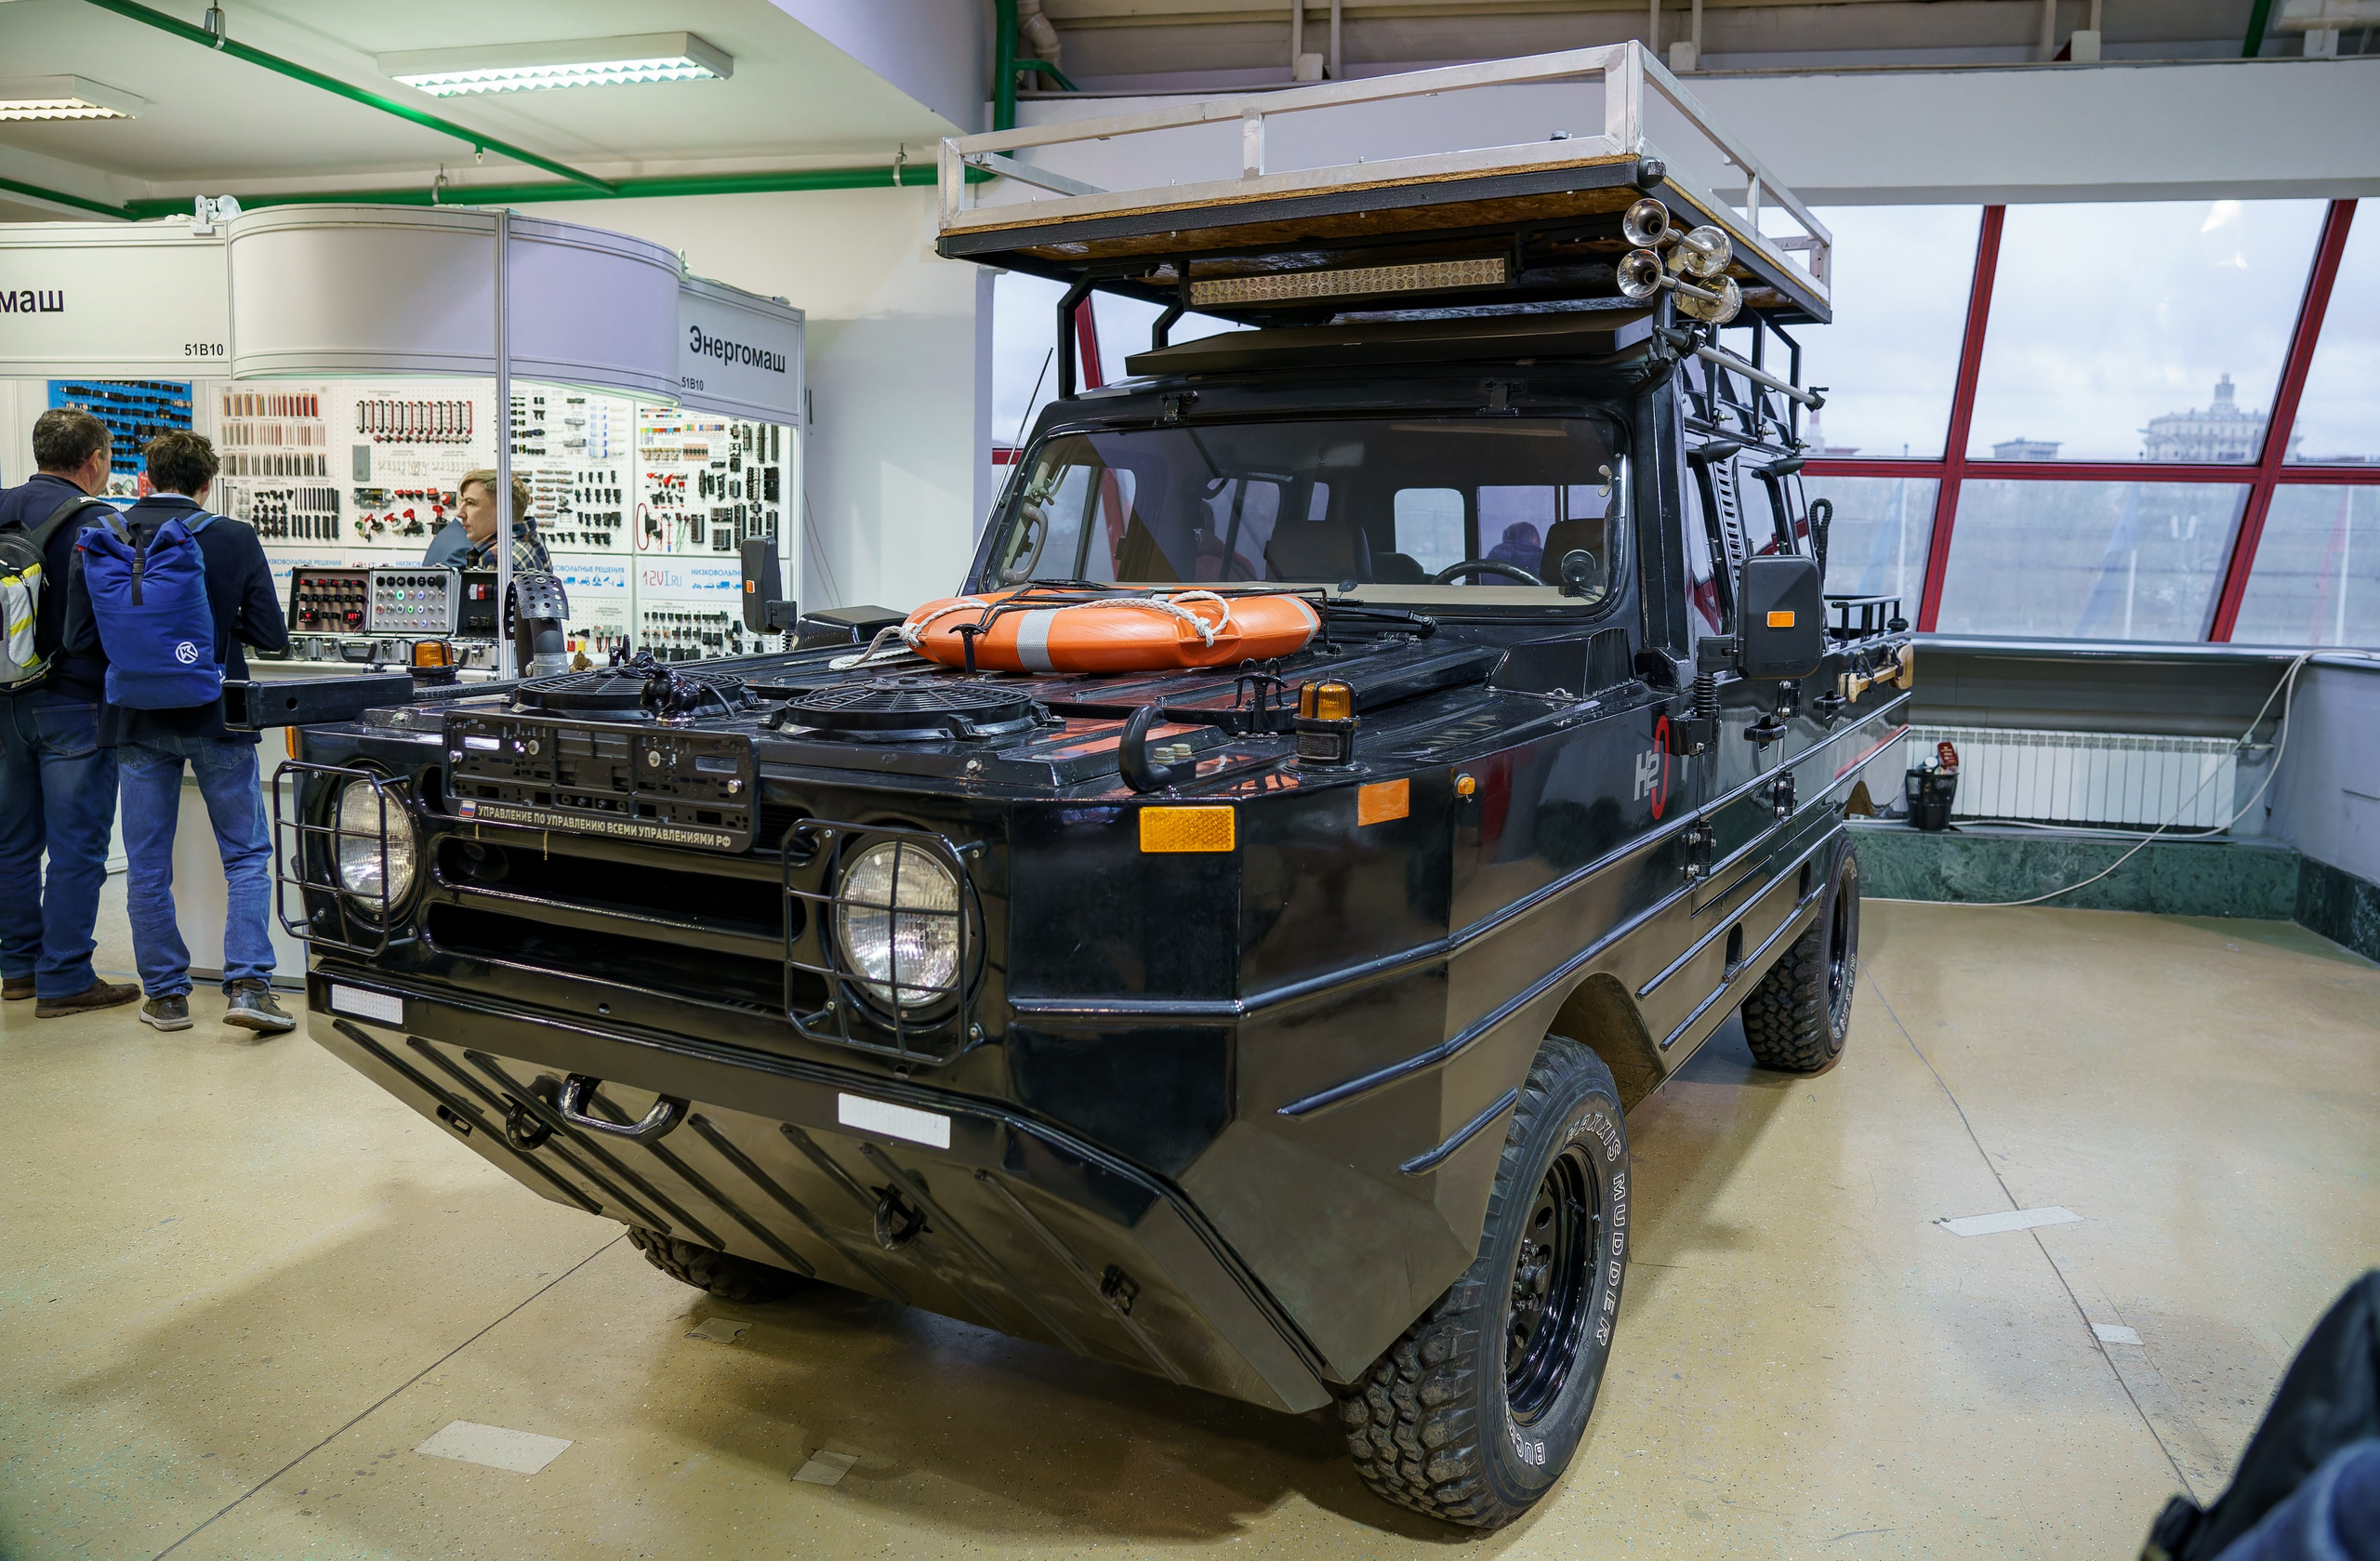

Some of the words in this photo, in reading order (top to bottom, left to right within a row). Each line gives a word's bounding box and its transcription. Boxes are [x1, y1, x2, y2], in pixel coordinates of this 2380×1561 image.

[184, 344, 224, 356] 51B10
[690, 325, 786, 374] Энергомаш
[681, 377, 704, 390] 51B10
[478, 805, 534, 822] УПРАВЛЕНИЕ
[534, 813, 546, 825] ПО
[546, 814, 605, 832] УПРАВЛЕНИЮ
[606, 822, 638, 837] ВСЕМИ
[638, 827, 715, 846] УПРАВЛЕНИЯМИ
[715, 835, 732, 848] РФ
[1595, 1172, 1627, 1347] MUDDER
